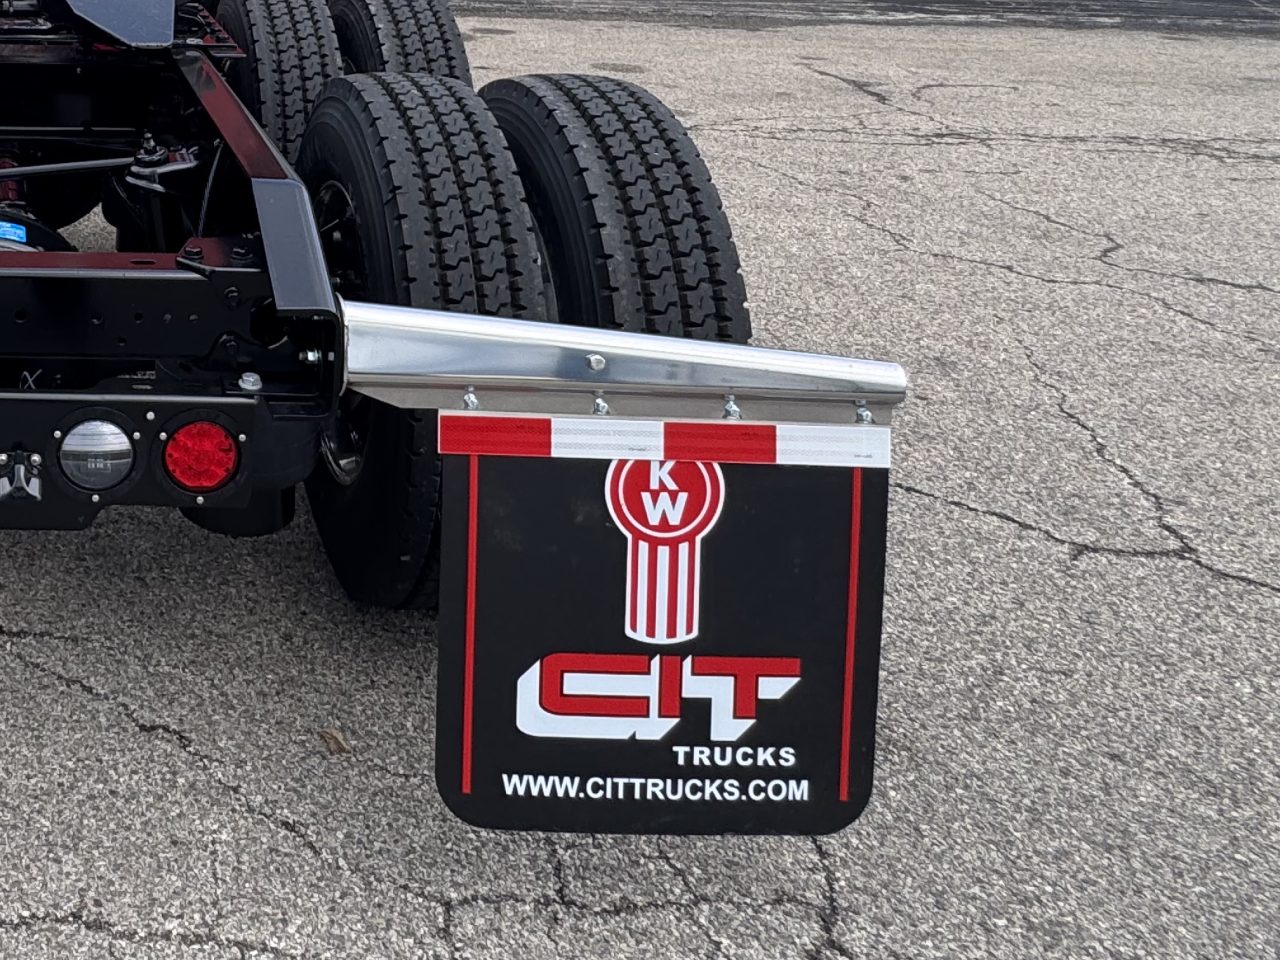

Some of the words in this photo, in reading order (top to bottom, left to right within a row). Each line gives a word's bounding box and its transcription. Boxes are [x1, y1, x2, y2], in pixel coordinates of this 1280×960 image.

[515, 652, 802, 742] CIT
[672, 745, 797, 767] TRUCKS
[502, 773, 810, 802] WWW.CITTRUCKS.COM
